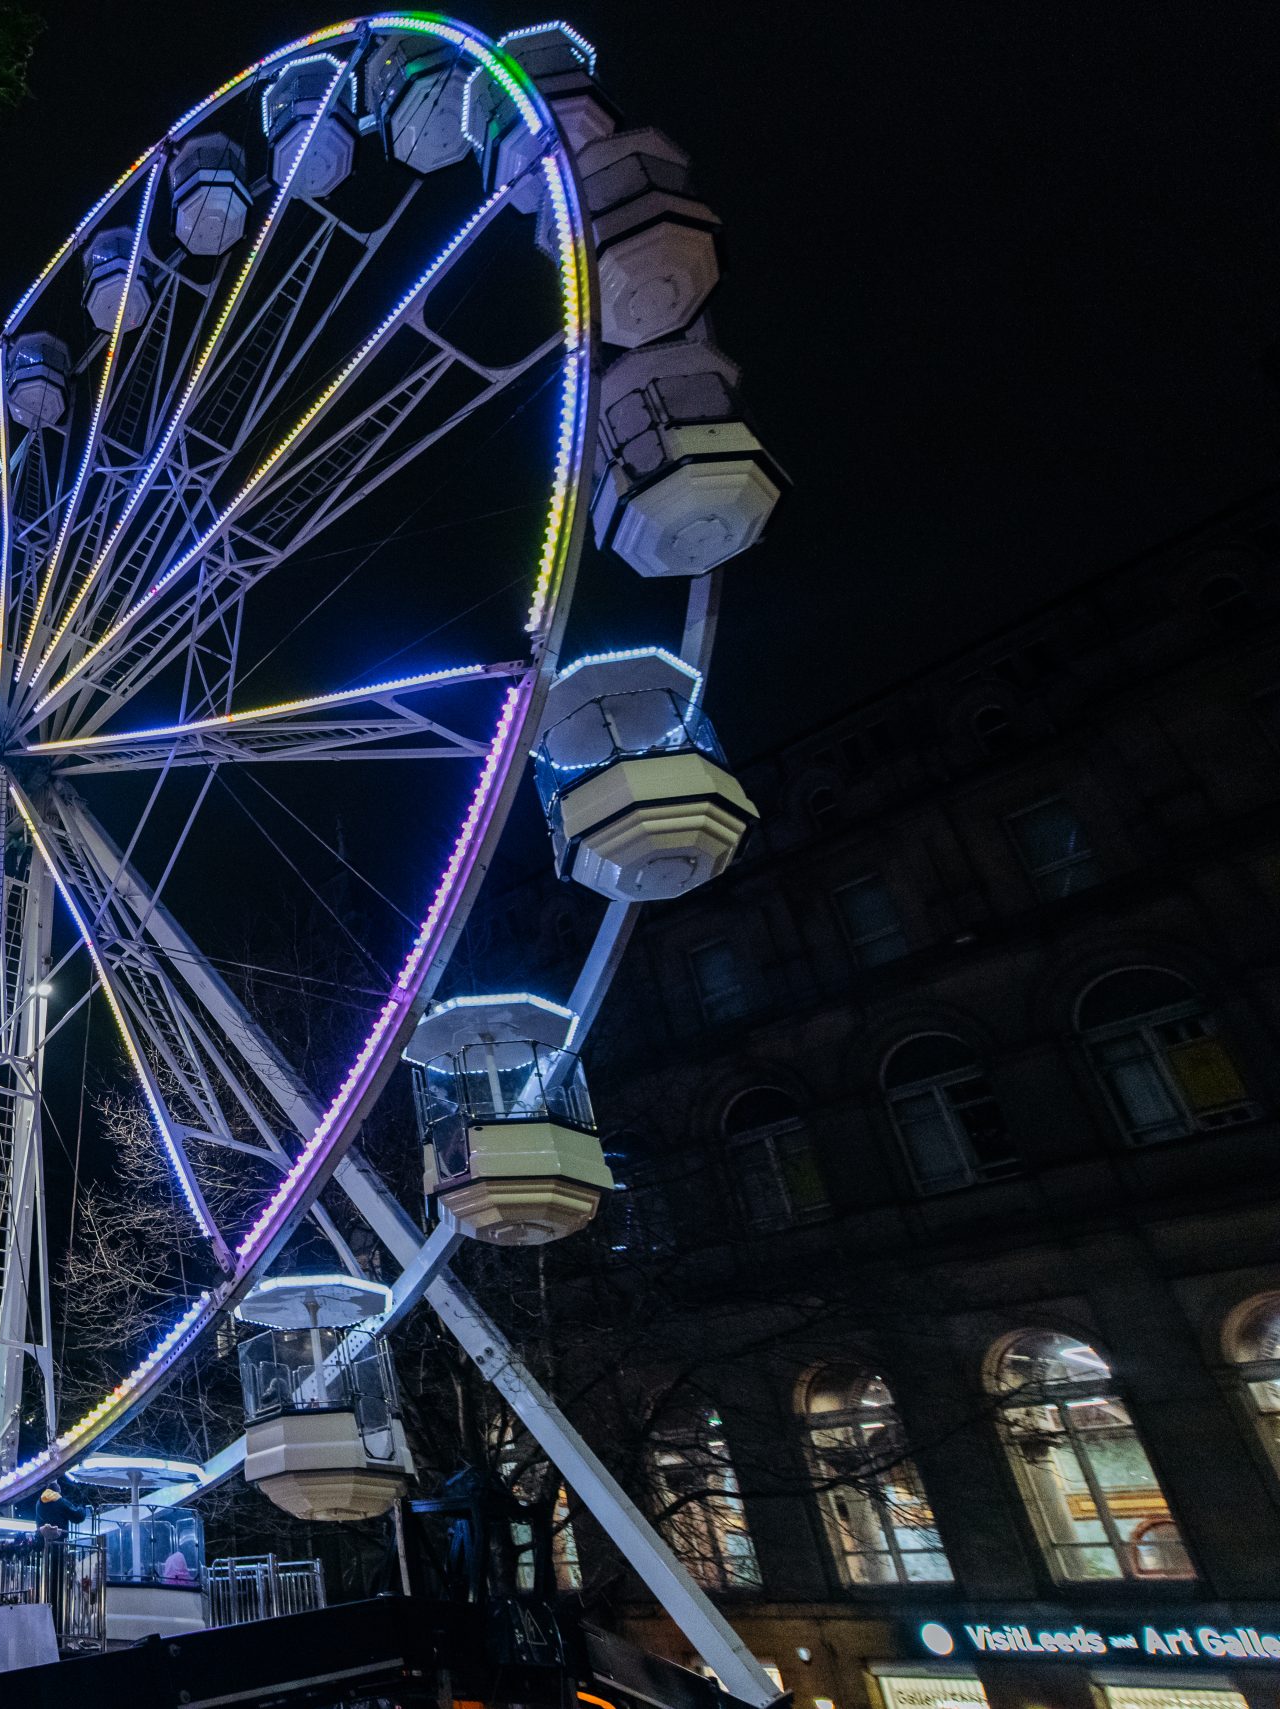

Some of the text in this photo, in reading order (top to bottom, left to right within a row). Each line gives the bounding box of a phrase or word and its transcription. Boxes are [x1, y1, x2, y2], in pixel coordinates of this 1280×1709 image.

[964, 1625, 1107, 1653] VisitLeeds
[1144, 1626, 1199, 1655] Art
[1197, 1627, 1280, 1658] Galle
